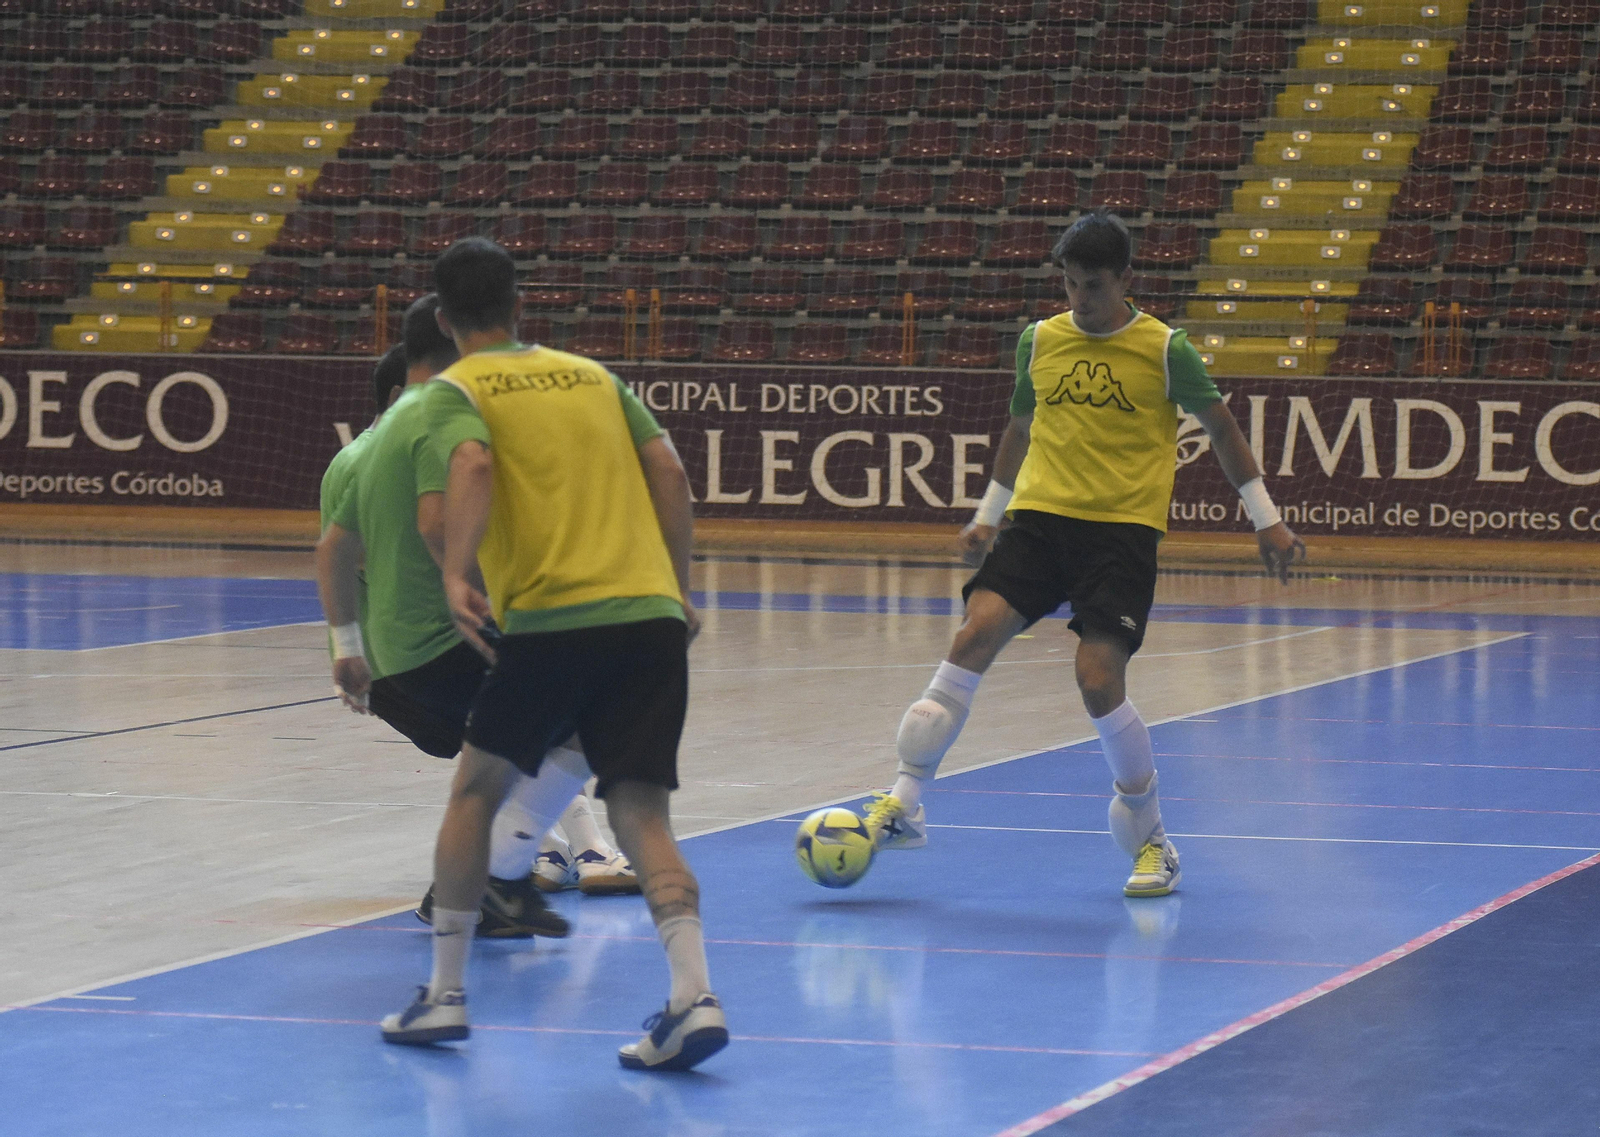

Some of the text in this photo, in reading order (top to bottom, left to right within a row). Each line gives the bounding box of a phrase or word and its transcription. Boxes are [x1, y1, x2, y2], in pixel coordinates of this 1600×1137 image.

[476, 369, 602, 396] Kappa
[628, 381, 944, 417] ICIPAL DEPORTES
[0, 370, 229, 452] ECO
[0, 470, 224, 498] eportes Córdoba
[660, 428, 990, 509] LEGRE
[1170, 499, 1227, 521] tuto
[1236, 499, 1374, 530] Mnicipal
[1383, 503, 1420, 527] de
[1429, 504, 1561, 534] Deportes
